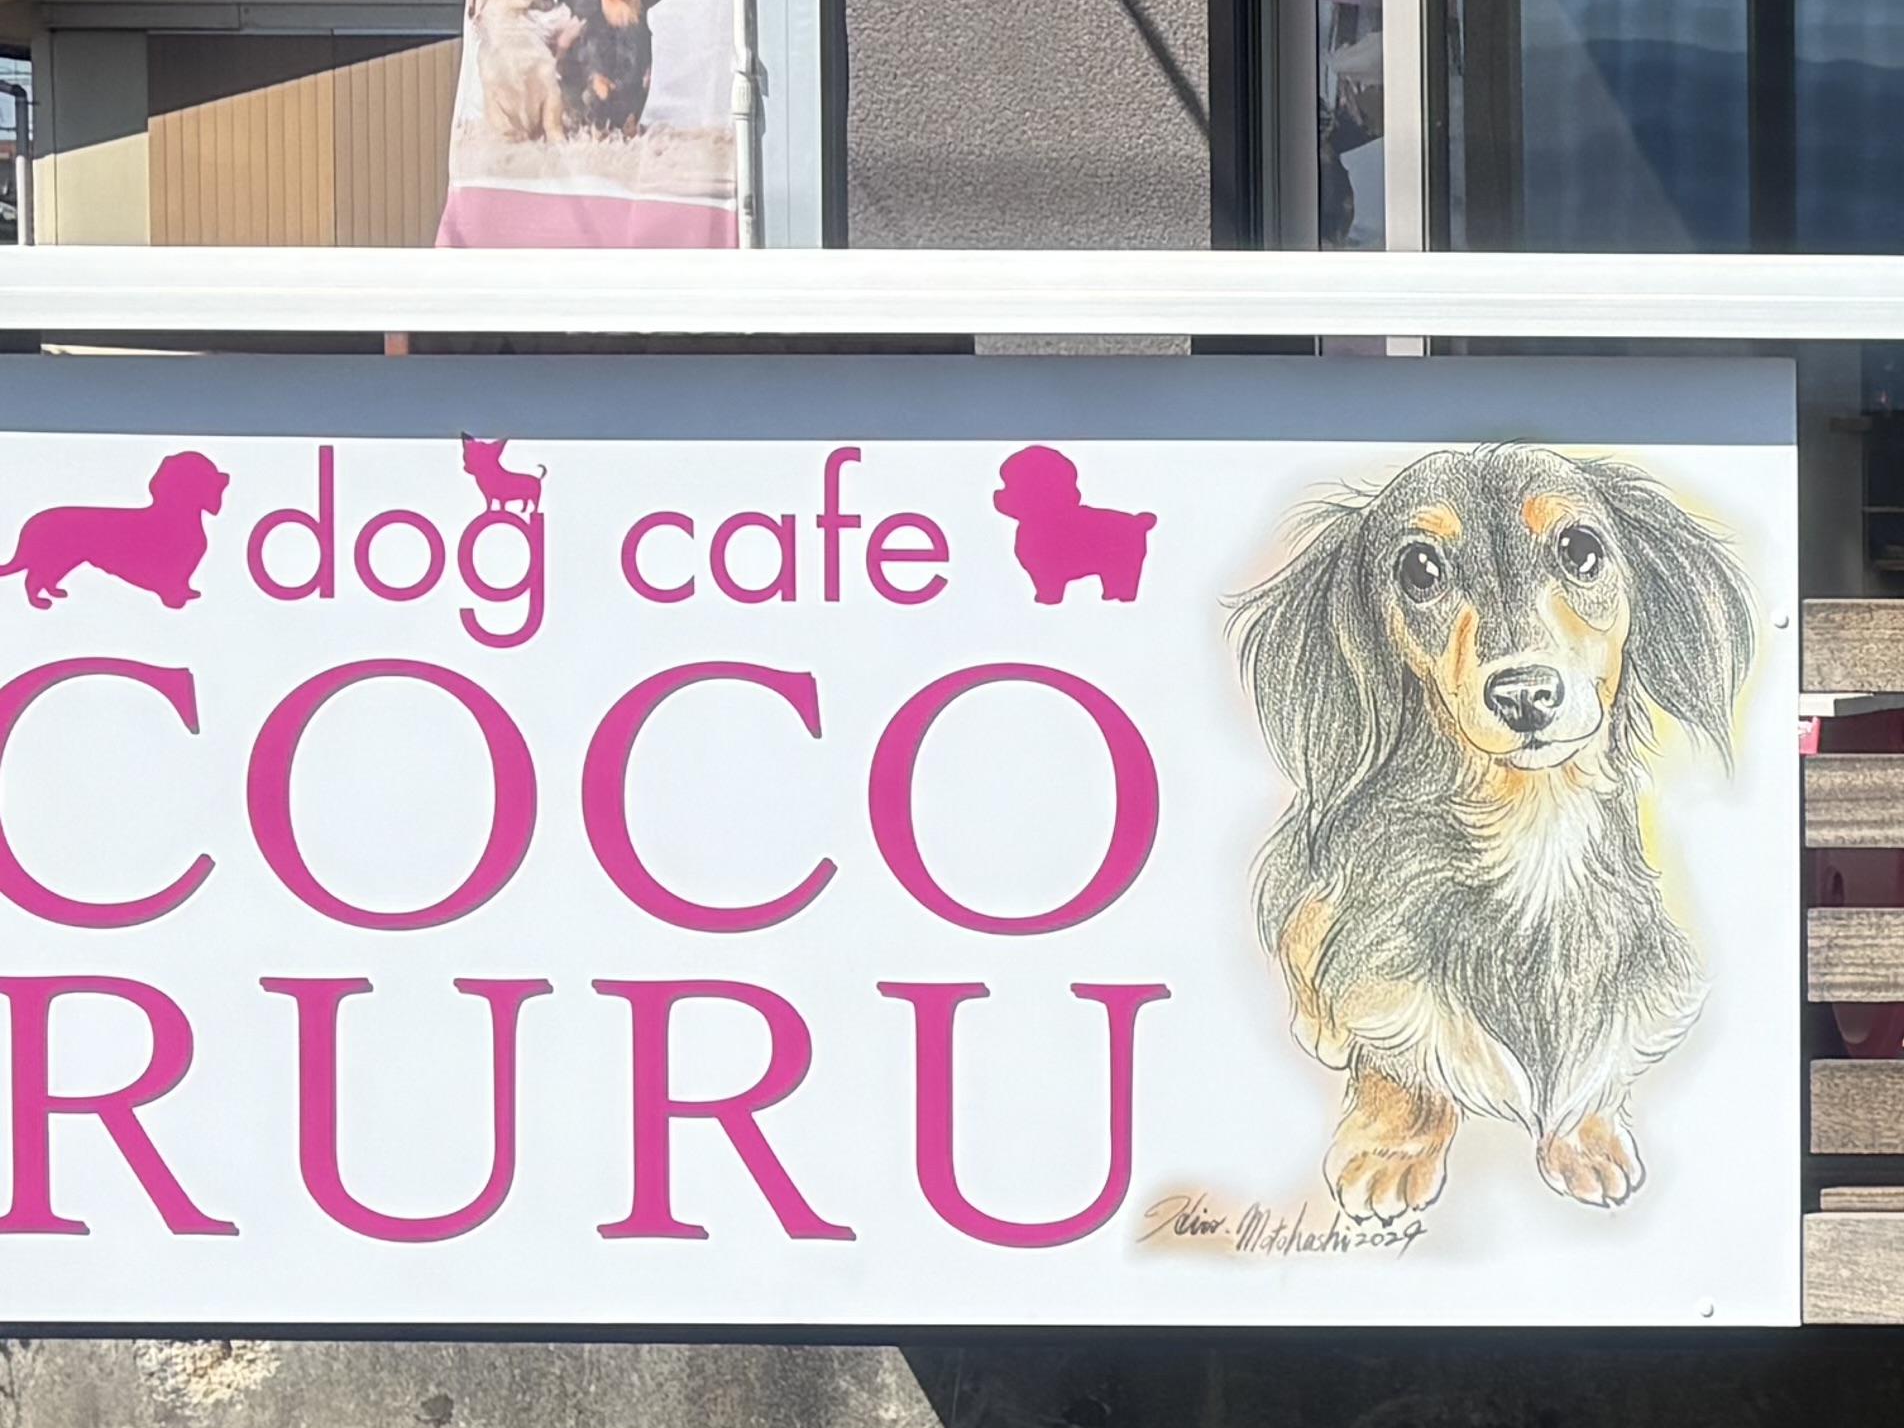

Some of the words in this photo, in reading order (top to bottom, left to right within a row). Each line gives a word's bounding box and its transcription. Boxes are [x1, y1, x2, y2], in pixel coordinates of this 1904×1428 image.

[246, 445, 546, 650] dog
[620, 446, 950, 605] cafe
[0, 656, 1160, 935] COCO
[0, 975, 1170, 1248] RURU
